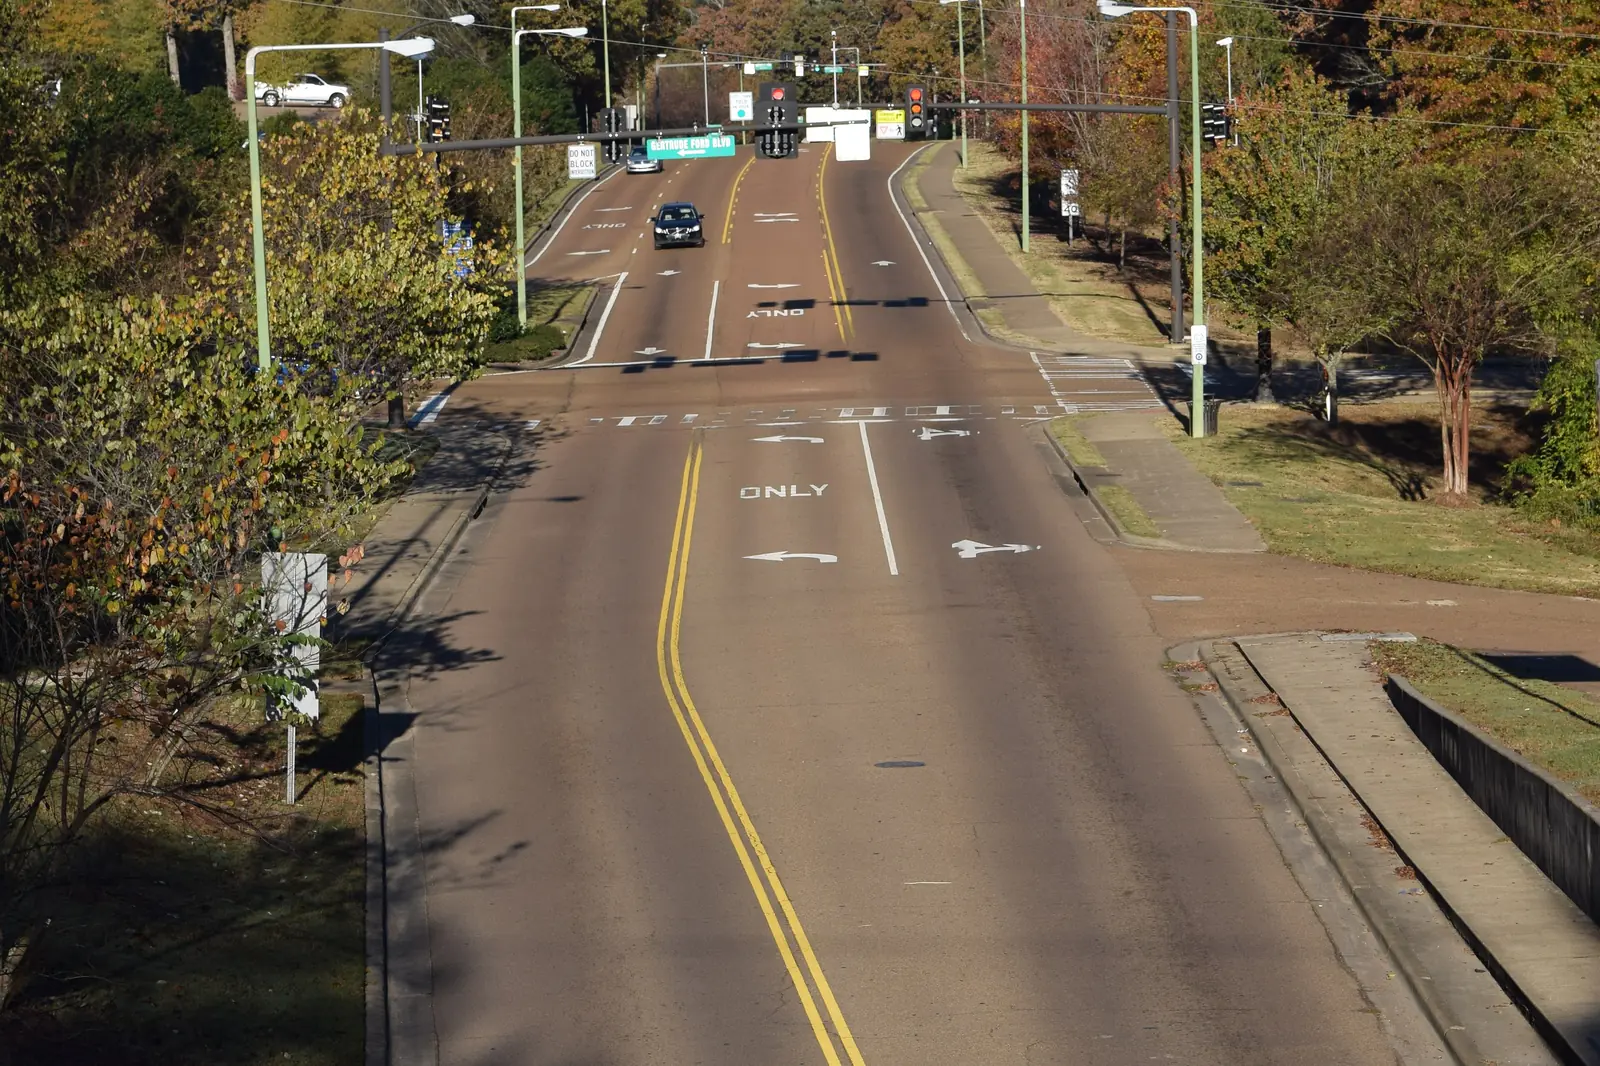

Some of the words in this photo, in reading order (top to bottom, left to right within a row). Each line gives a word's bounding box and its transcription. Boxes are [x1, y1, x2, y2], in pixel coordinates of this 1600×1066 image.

[650, 139, 688, 151] GERTRUDE
[690, 138, 710, 149] FORD
[712, 137, 731, 148] BLVD
[581, 149, 593, 157] NOT
[570, 160, 594, 168] BLOCK
[581, 222, 627, 230] ONLY
[746, 308, 804, 319] ONLY
[739, 483, 829, 499] ONLY
